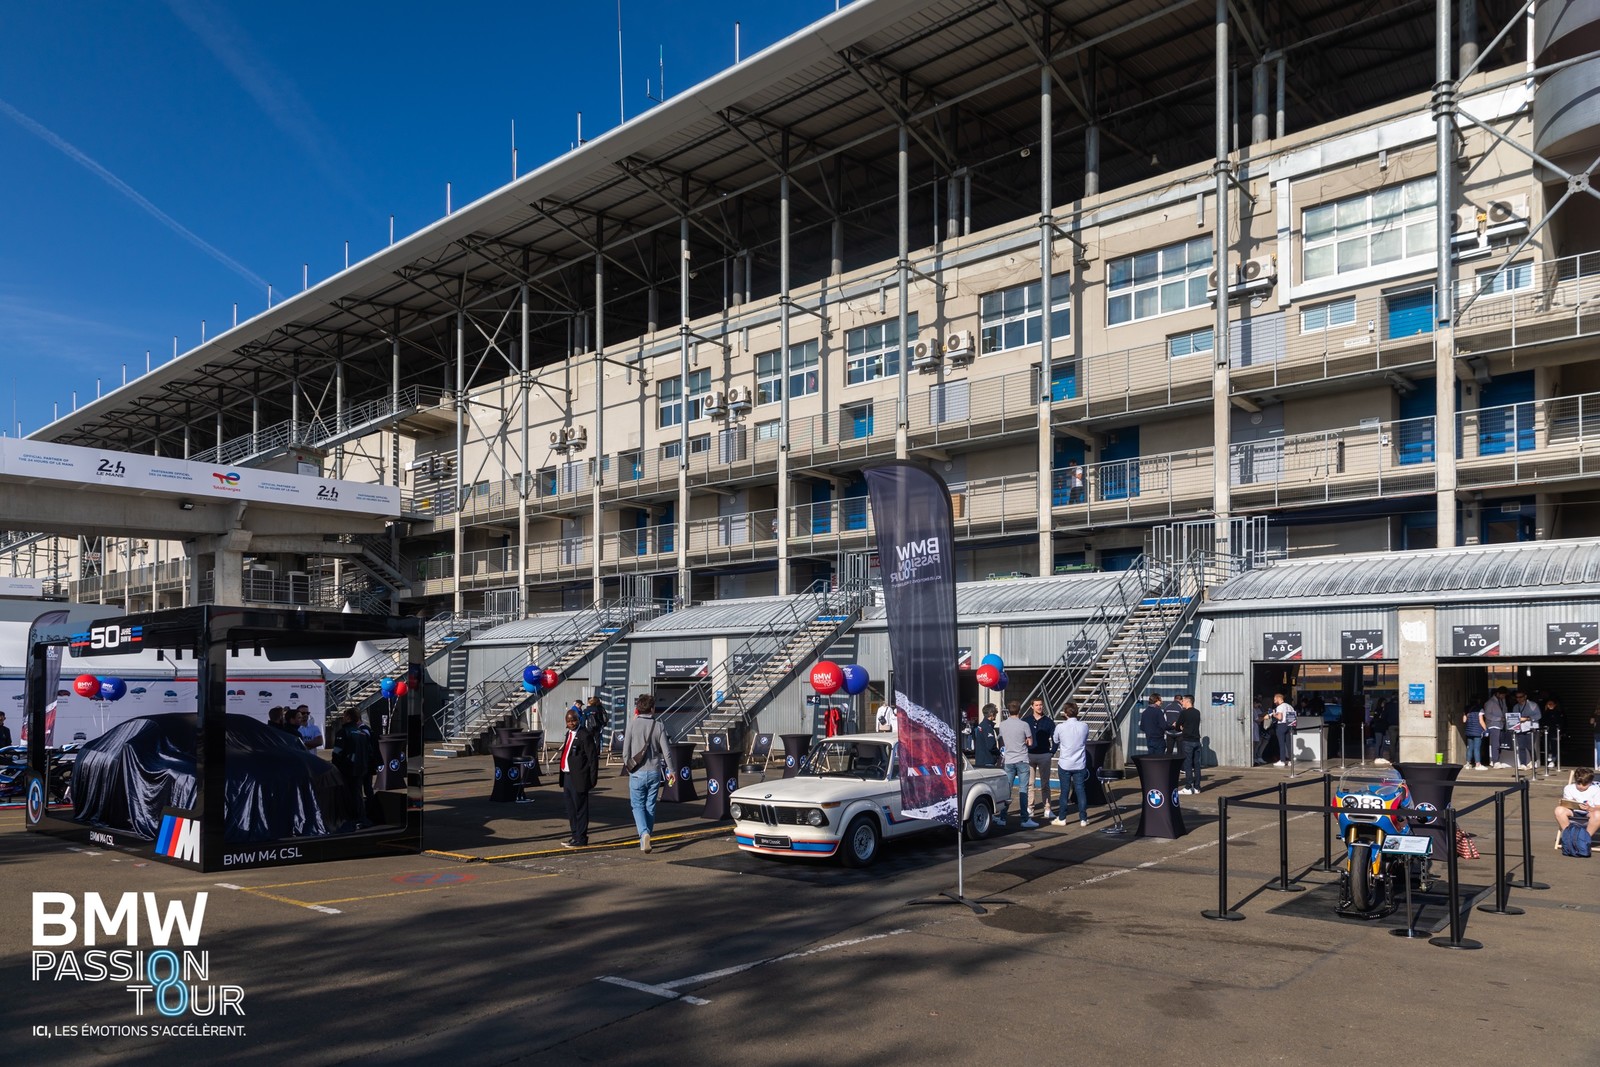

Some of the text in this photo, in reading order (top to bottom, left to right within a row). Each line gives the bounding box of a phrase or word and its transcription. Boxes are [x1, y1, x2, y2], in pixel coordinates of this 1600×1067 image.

[97, 458, 126, 473] 24h
[317, 485, 339, 498] 24h
[91, 625, 120, 649] 50
[1558, 637, 1588, 646] P à Z
[1349, 643, 1356, 651] D
[1464, 638, 1487, 647] I à O
[1271, 644, 1294, 652] A à C
[813, 672, 832, 680] BMW
[811, 696, 820, 704] 42
[1220, 693, 1234, 702] 45
[89, 830, 115, 846] BMW M4 CSL
[223, 847, 303, 866] BMW M4 CSL
